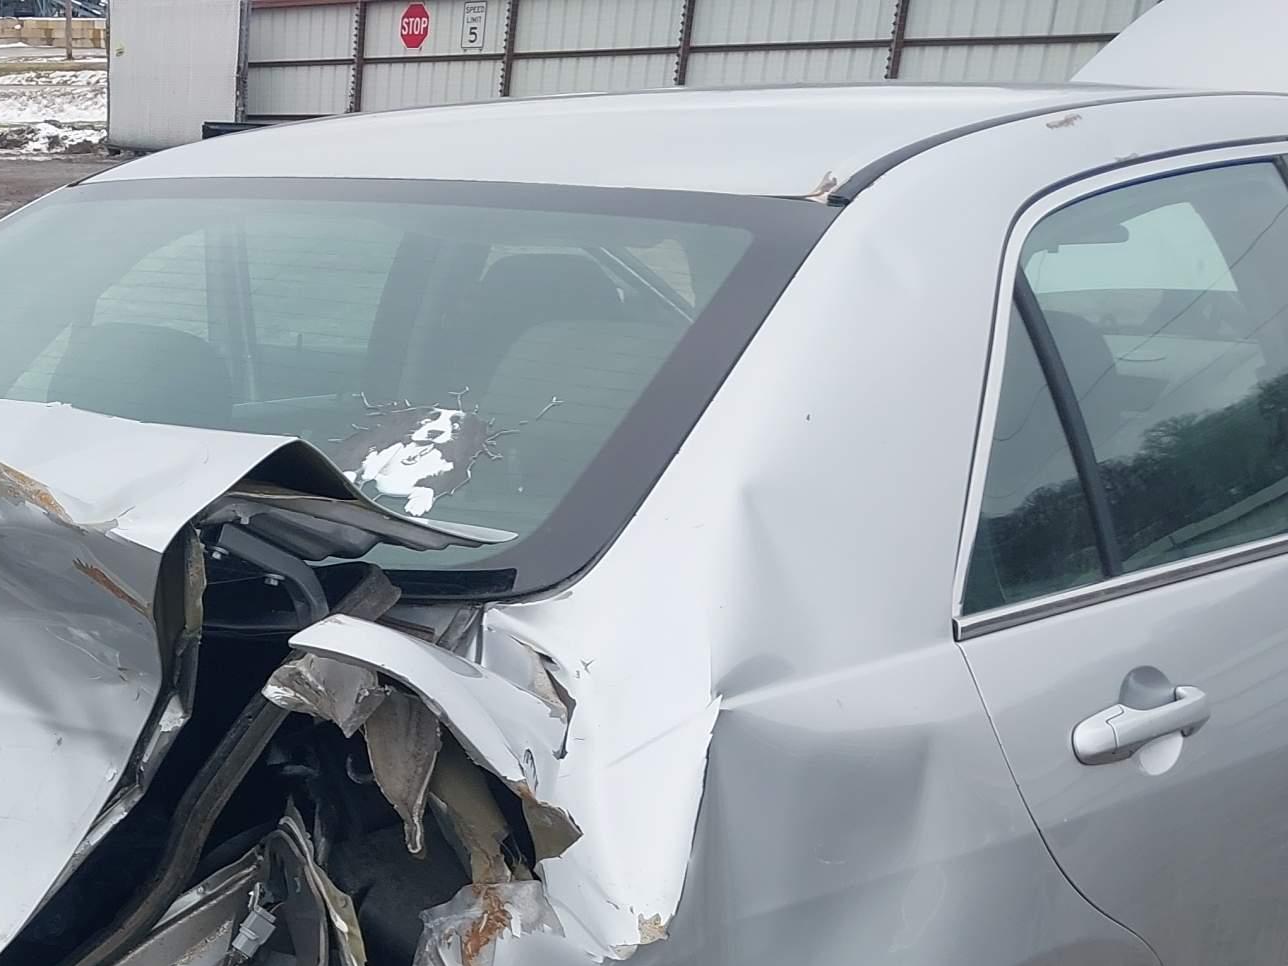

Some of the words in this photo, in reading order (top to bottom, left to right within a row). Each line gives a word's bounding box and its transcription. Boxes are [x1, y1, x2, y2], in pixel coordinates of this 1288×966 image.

[466, 6, 485, 14] SPEED
[466, 16, 482, 24] LIMIT
[402, 18, 428, 35] STOP
[468, 27, 478, 43] 5
